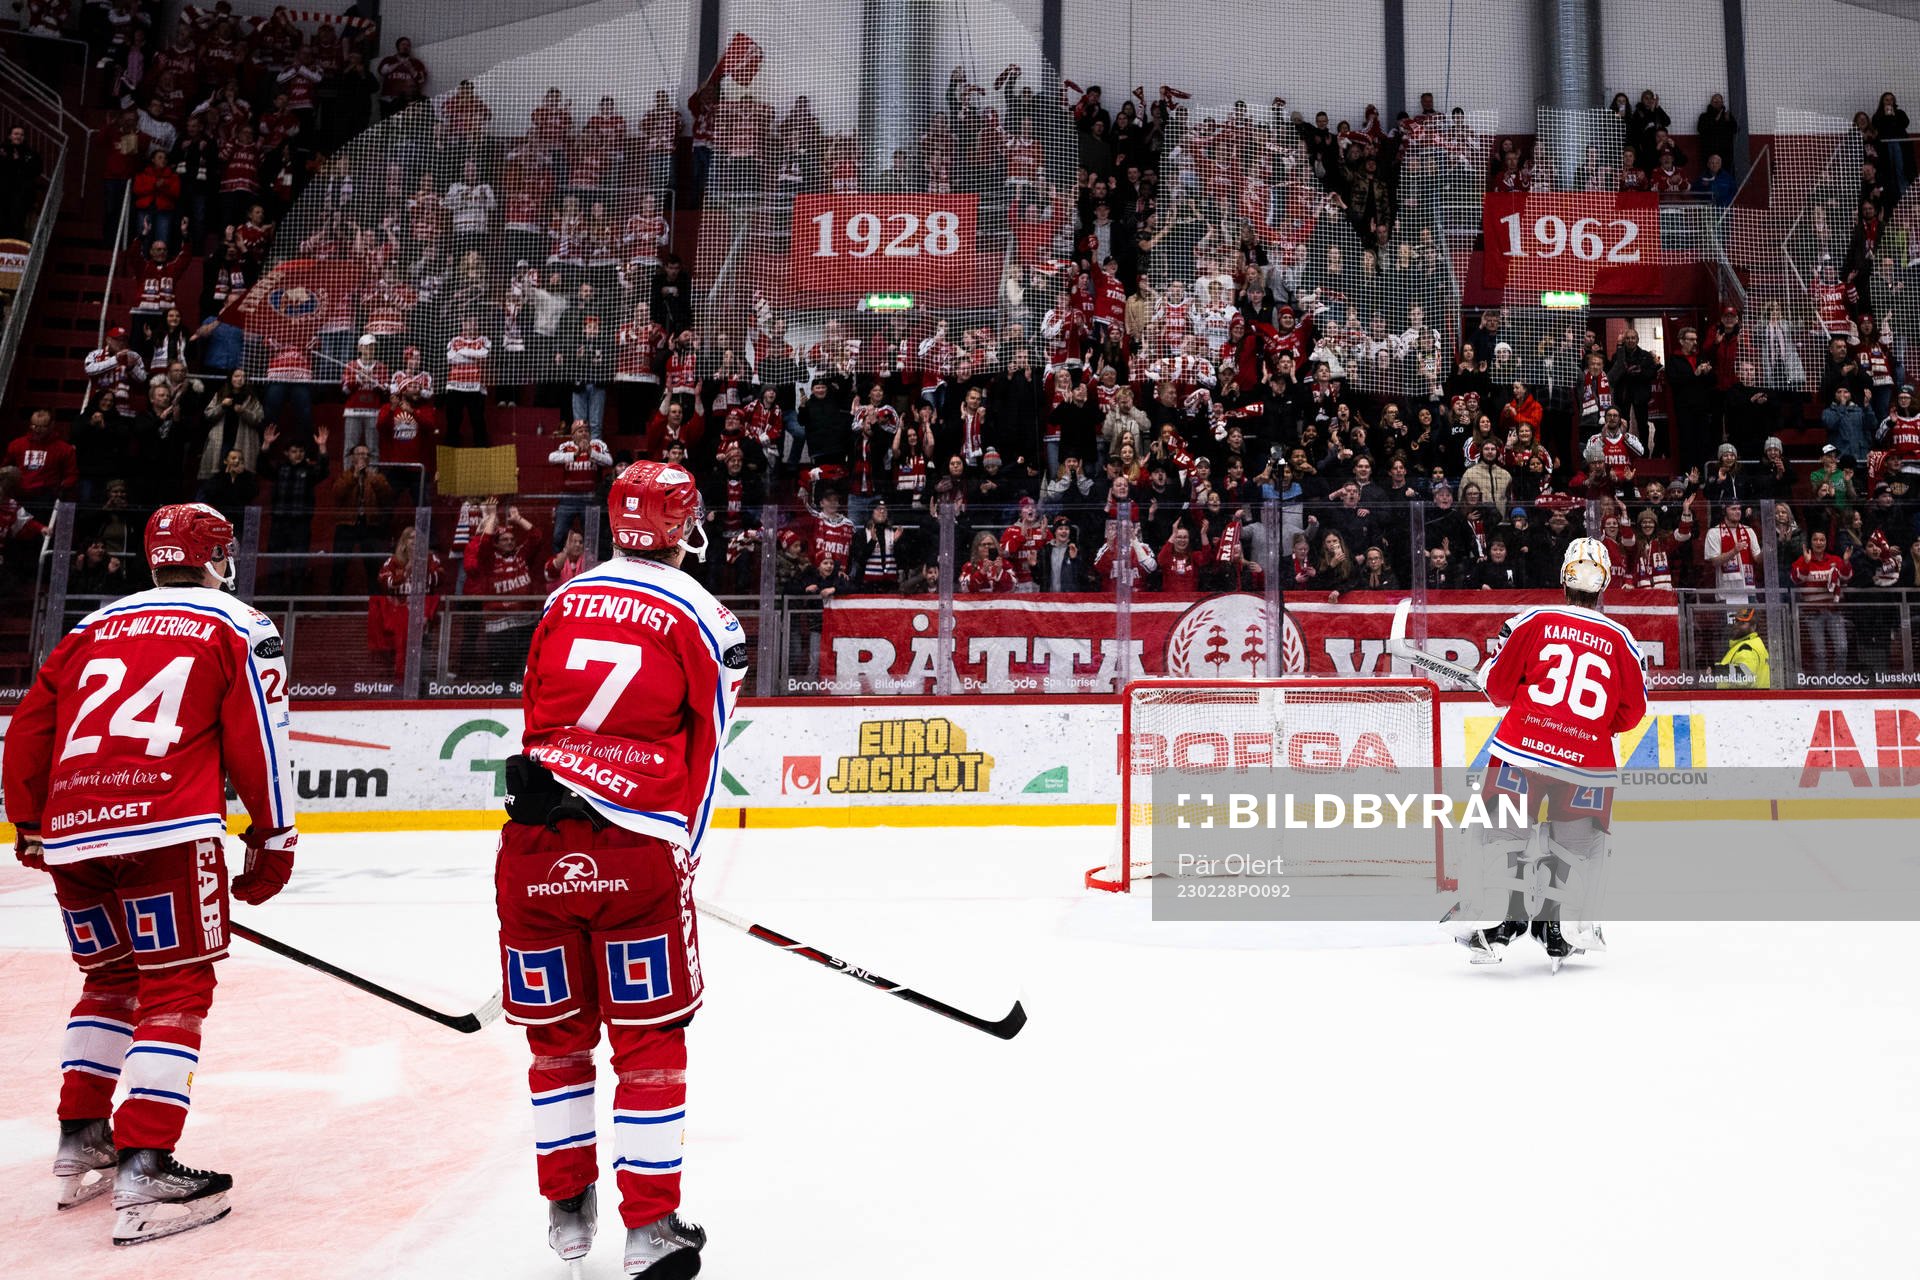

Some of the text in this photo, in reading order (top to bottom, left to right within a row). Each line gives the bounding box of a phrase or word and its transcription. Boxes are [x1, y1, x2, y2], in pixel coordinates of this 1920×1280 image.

[811, 210, 960, 258] 1928
[1500, 212, 1641, 263] 1962
[629, 532, 639, 546] 7
[157, 549, 173, 563] 24
[563, 594, 678, 636] STENQVIST
[1544, 625, 1613, 656] KAARLEHTO
[354, 680, 394, 694] Skyltar
[565, 638, 642, 734] 7
[1528, 643, 1611, 721] 36
[1698, 673, 1757, 686] Arbetskläder
[60, 657, 195, 764] 24
[859, 718, 951, 757] EURO
[1563, 724, 1579, 736] with
[1578, 727, 1592, 741] love
[593, 745, 622, 762] with
[624, 746, 651, 765] love
[1521, 737, 1586, 764] BILBOLAGET
[102, 769, 129, 786] with
[132, 768, 158, 785] love
[827, 752, 984, 793] JACKPOT
[1621, 772, 1708, 786] EUROCON
[51, 802, 152, 832] BILBOLAGET
[527, 878, 629, 897] PROLYMPIA
[830, 957, 877, 983] SYNC
